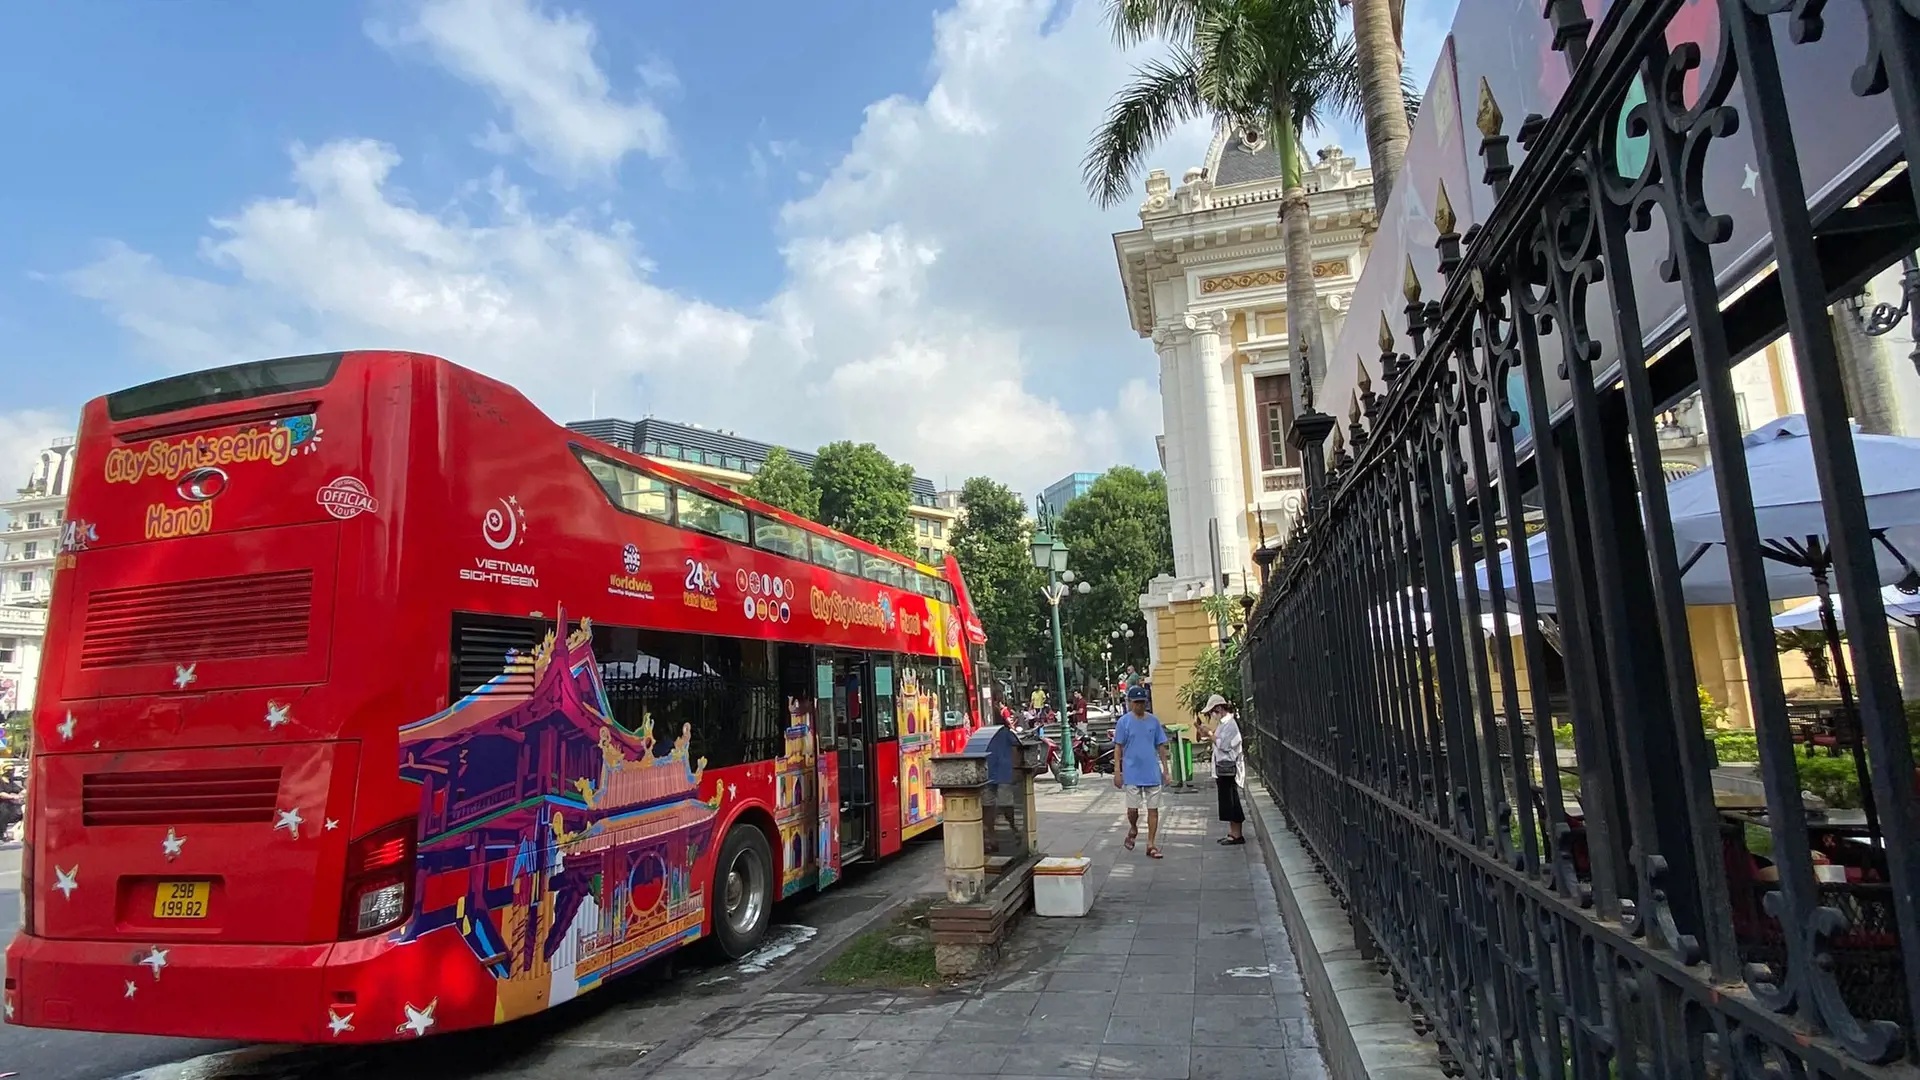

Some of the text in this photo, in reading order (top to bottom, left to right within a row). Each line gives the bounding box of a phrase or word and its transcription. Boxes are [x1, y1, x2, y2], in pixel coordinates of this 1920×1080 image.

[105, 427, 292, 485] CitySightseeing
[323, 489, 373, 510] OFFICIAL
[333, 504, 356, 516] TOUR
[145, 501, 213, 540] Hanoi
[475, 557, 535, 576] VIETNAM
[685, 558, 705, 592] 24
[810, 585, 887, 634] CitySightseeing
[899, 607, 921, 635] Hanoi
[171, 883, 195, 899] 29B
[161, 900, 202, 916] 199.82
